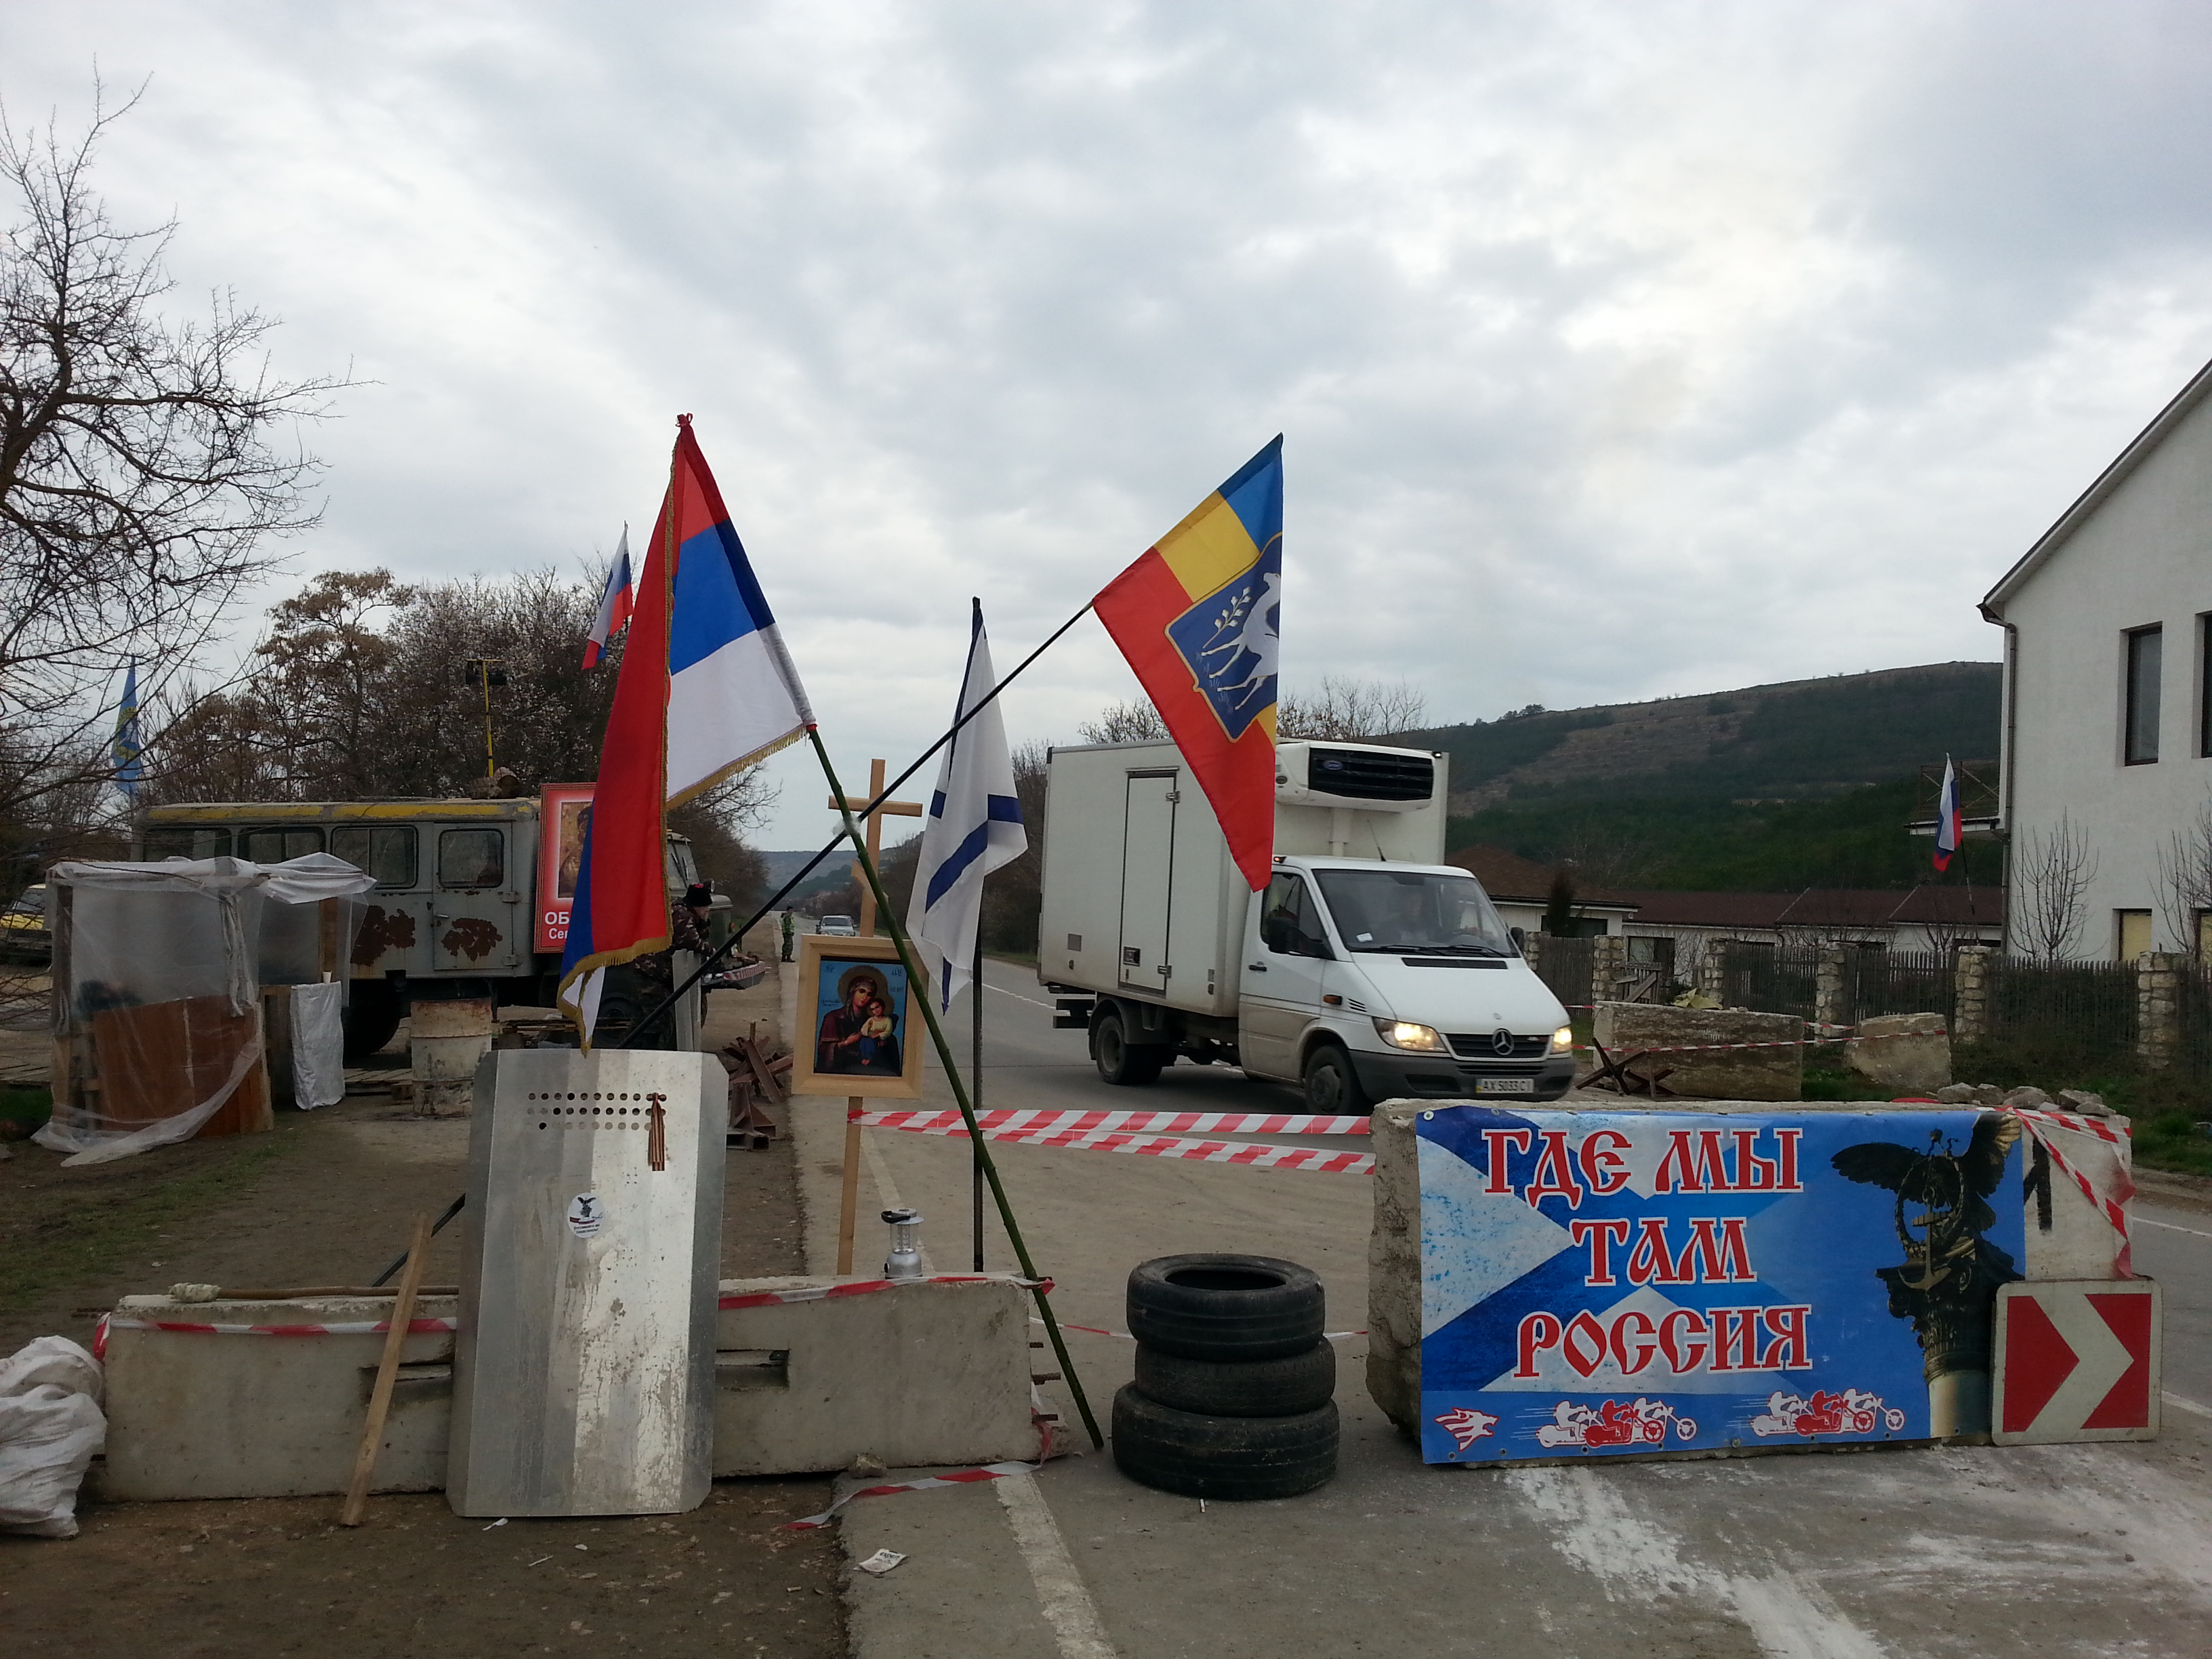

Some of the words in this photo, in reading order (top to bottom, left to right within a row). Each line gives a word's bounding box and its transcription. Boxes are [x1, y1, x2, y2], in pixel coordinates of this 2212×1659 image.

[1482, 1128, 1633, 1209] ГДЕ
[1655, 1128, 1804, 1194] МЫ
[1570, 1217, 1757, 1286] ТАМ
[1512, 1305, 1812, 1380] РОССИЯ
